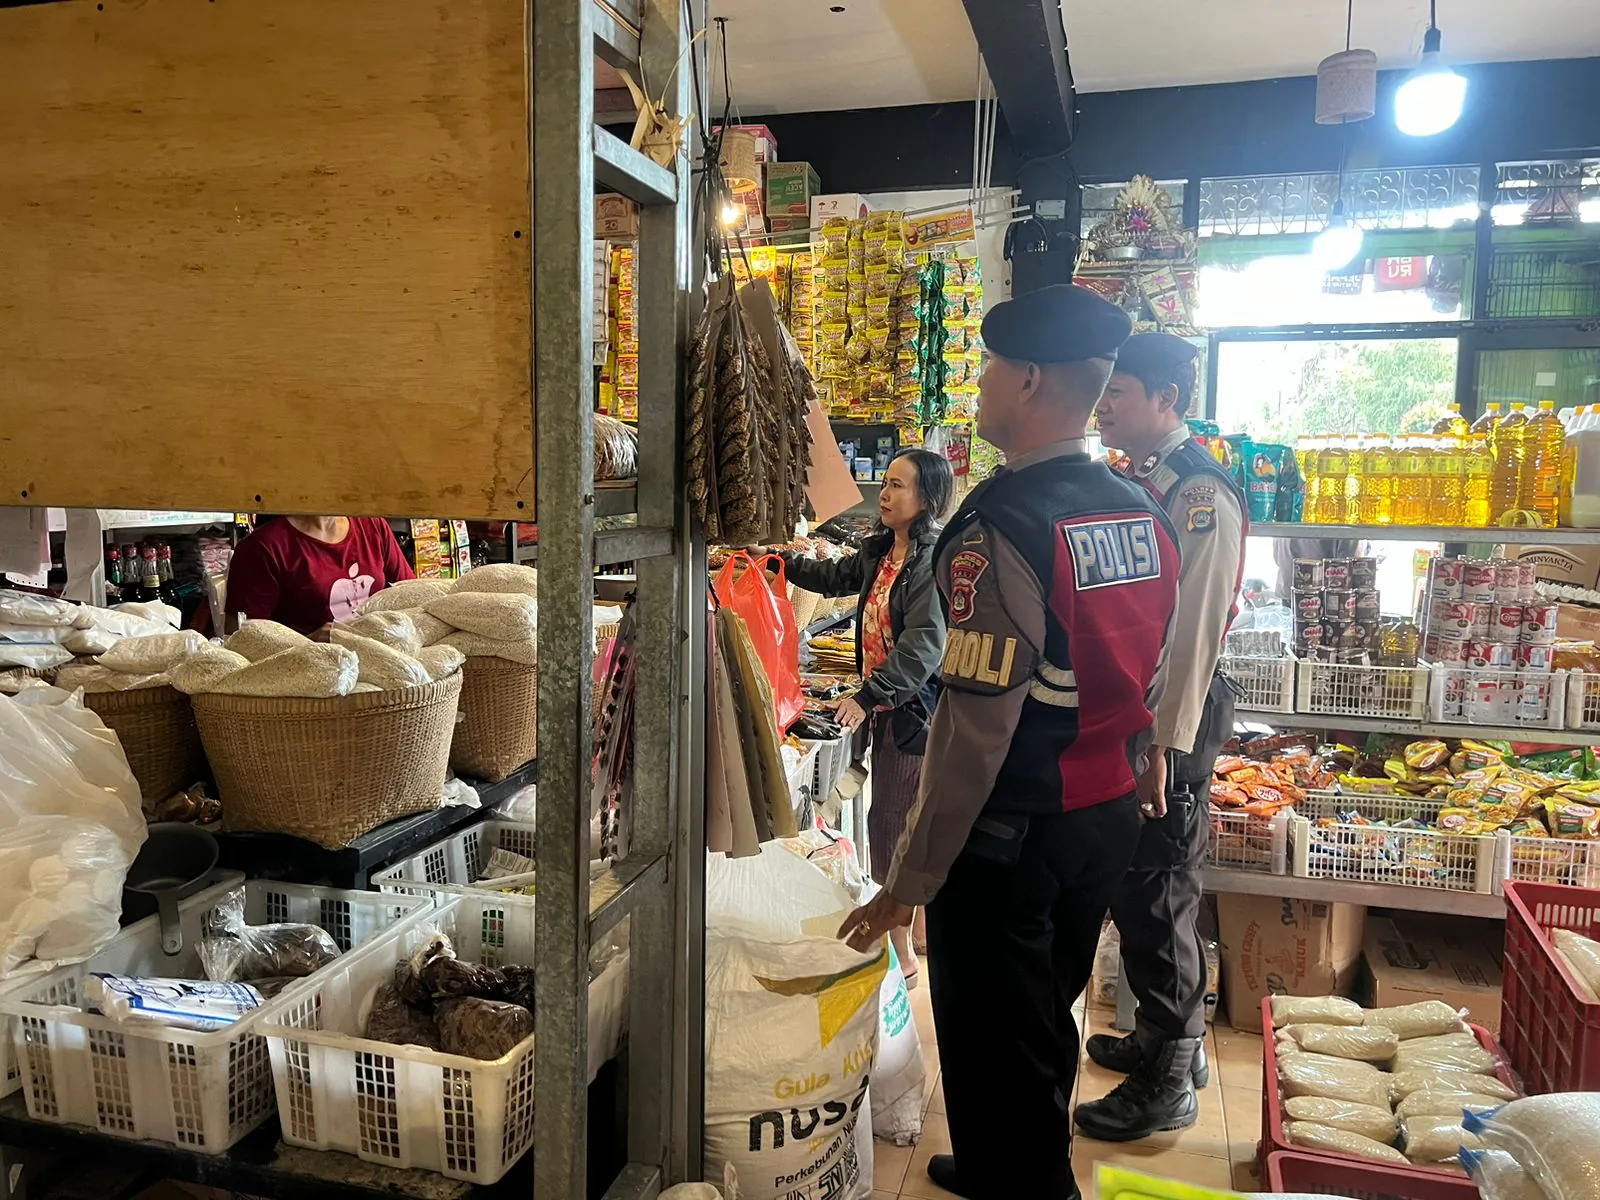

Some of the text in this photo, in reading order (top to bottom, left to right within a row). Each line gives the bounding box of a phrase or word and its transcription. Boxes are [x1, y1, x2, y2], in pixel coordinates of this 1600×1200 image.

[1071, 523, 1159, 584] POLISI
[775, 1073, 831, 1100] Gula
[775, 1135, 843, 1188] Perkebunan
